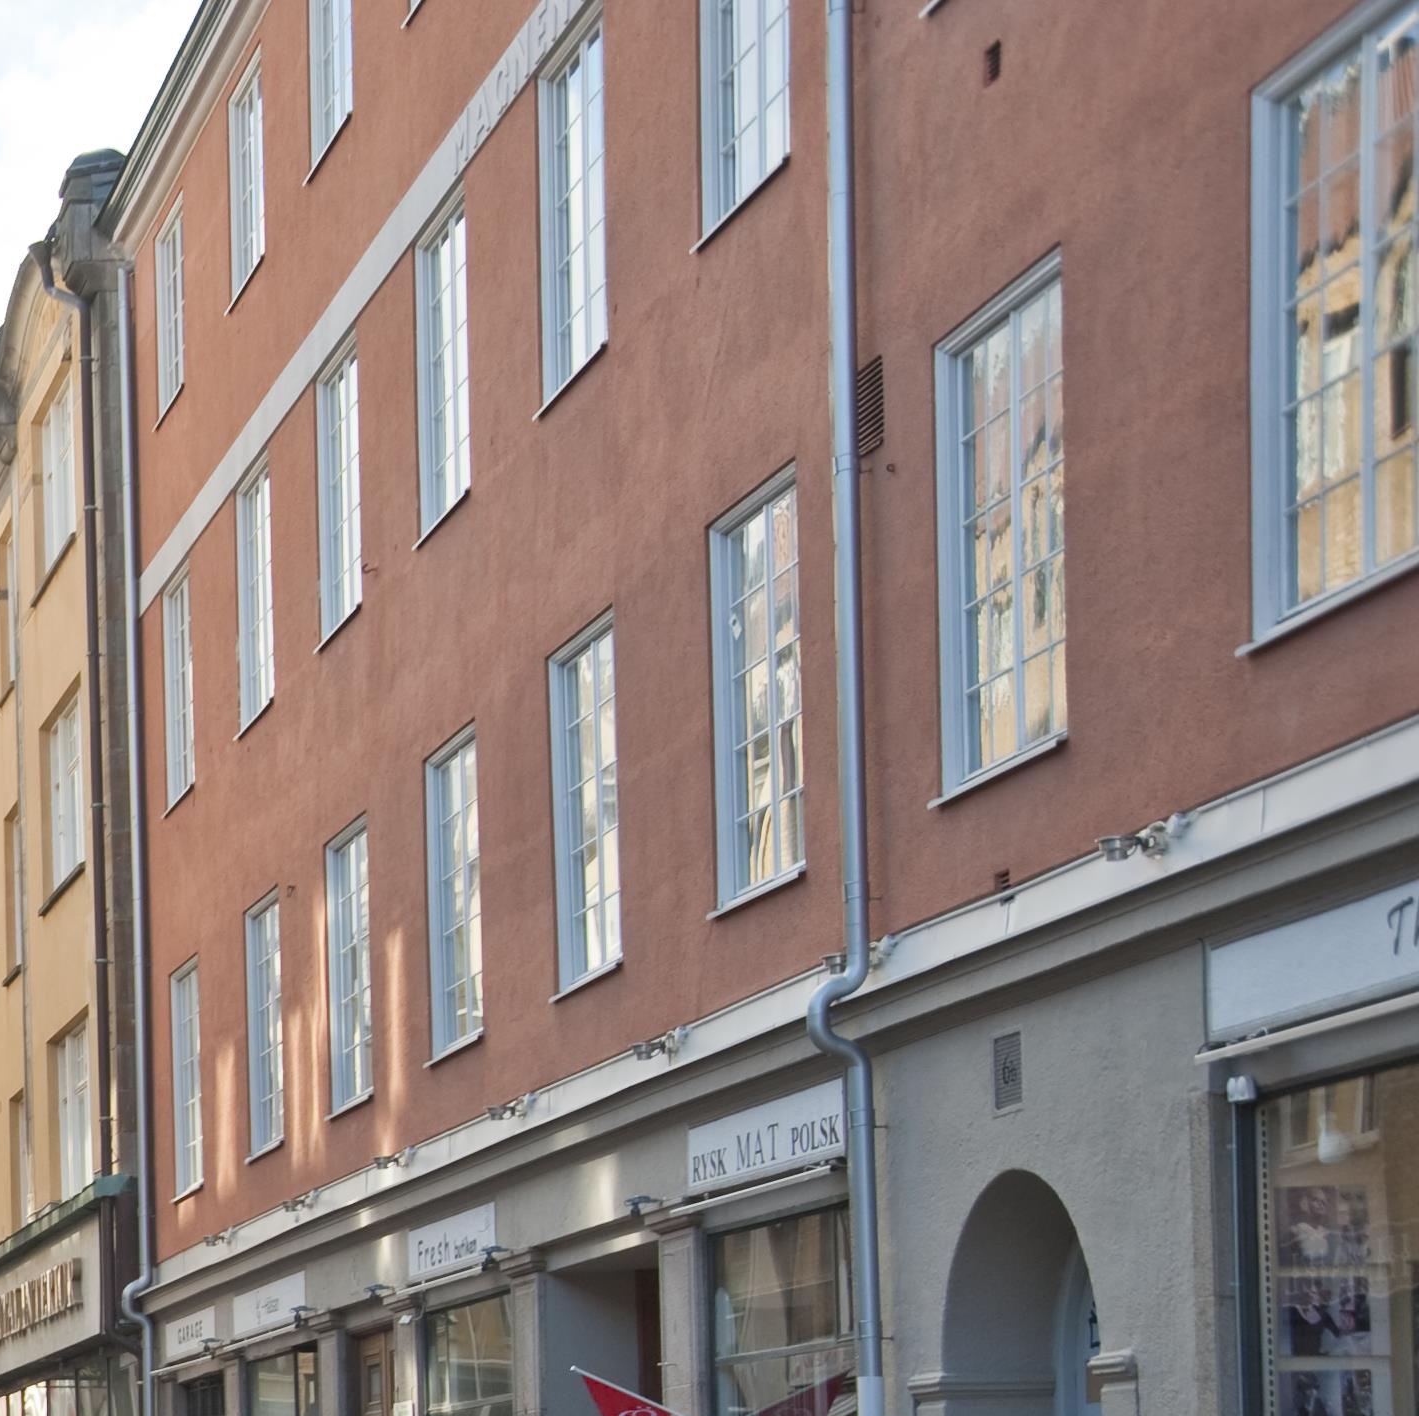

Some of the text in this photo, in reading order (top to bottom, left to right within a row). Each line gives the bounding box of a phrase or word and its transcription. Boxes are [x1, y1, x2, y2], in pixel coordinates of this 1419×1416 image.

[692, 1114, 840, 1183] RYSK MAT POLSK
[418, 1232, 450, 1271] Fresh
[177, 1320, 203, 1345] GARAGE
